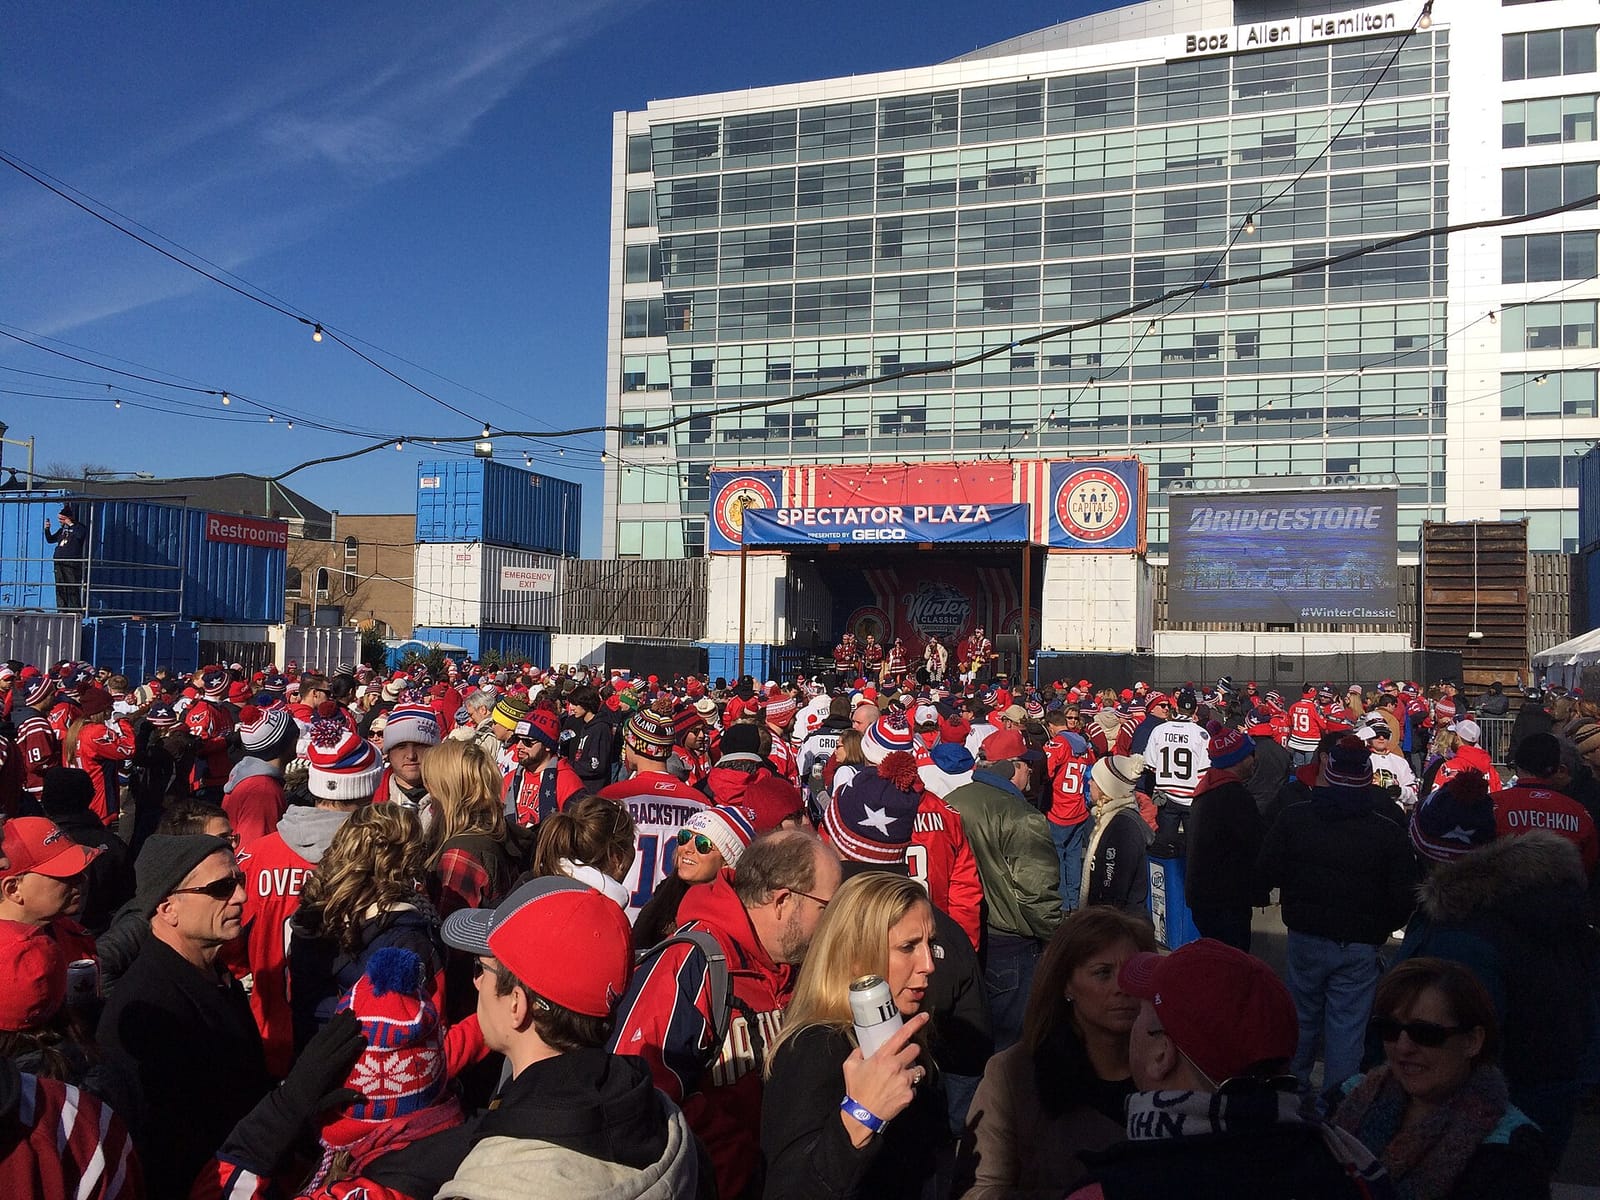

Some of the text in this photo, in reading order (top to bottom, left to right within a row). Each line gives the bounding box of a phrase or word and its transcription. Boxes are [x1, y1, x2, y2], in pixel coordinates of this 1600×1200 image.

[1186, 11, 1395, 53] Booz Allen Hamilton
[776, 505, 992, 526] SPECTATOR PLAZA
[1073, 502, 1113, 512] CAPITALS
[1187, 506, 1383, 532] BRIDGESTONE
[210, 519, 286, 544] Restrooms
[852, 528, 906, 540] GEICO
[504, 570, 553, 581] EMERGENCY
[519, 581, 537, 589] EXIT
[903, 592, 972, 622] Winter
[1300, 607, 1396, 619] #WinterClassic
[921, 616, 958, 624] CLASSIC
[1293, 713, 1310, 732] 19
[1164, 732, 1189, 744] TOEWS
[28, 747, 41, 763] 19
[1159, 746, 1193, 780] 19
[628, 803, 703, 826] BACKSTR
[1508, 810, 1579, 833] OVECHKIN
